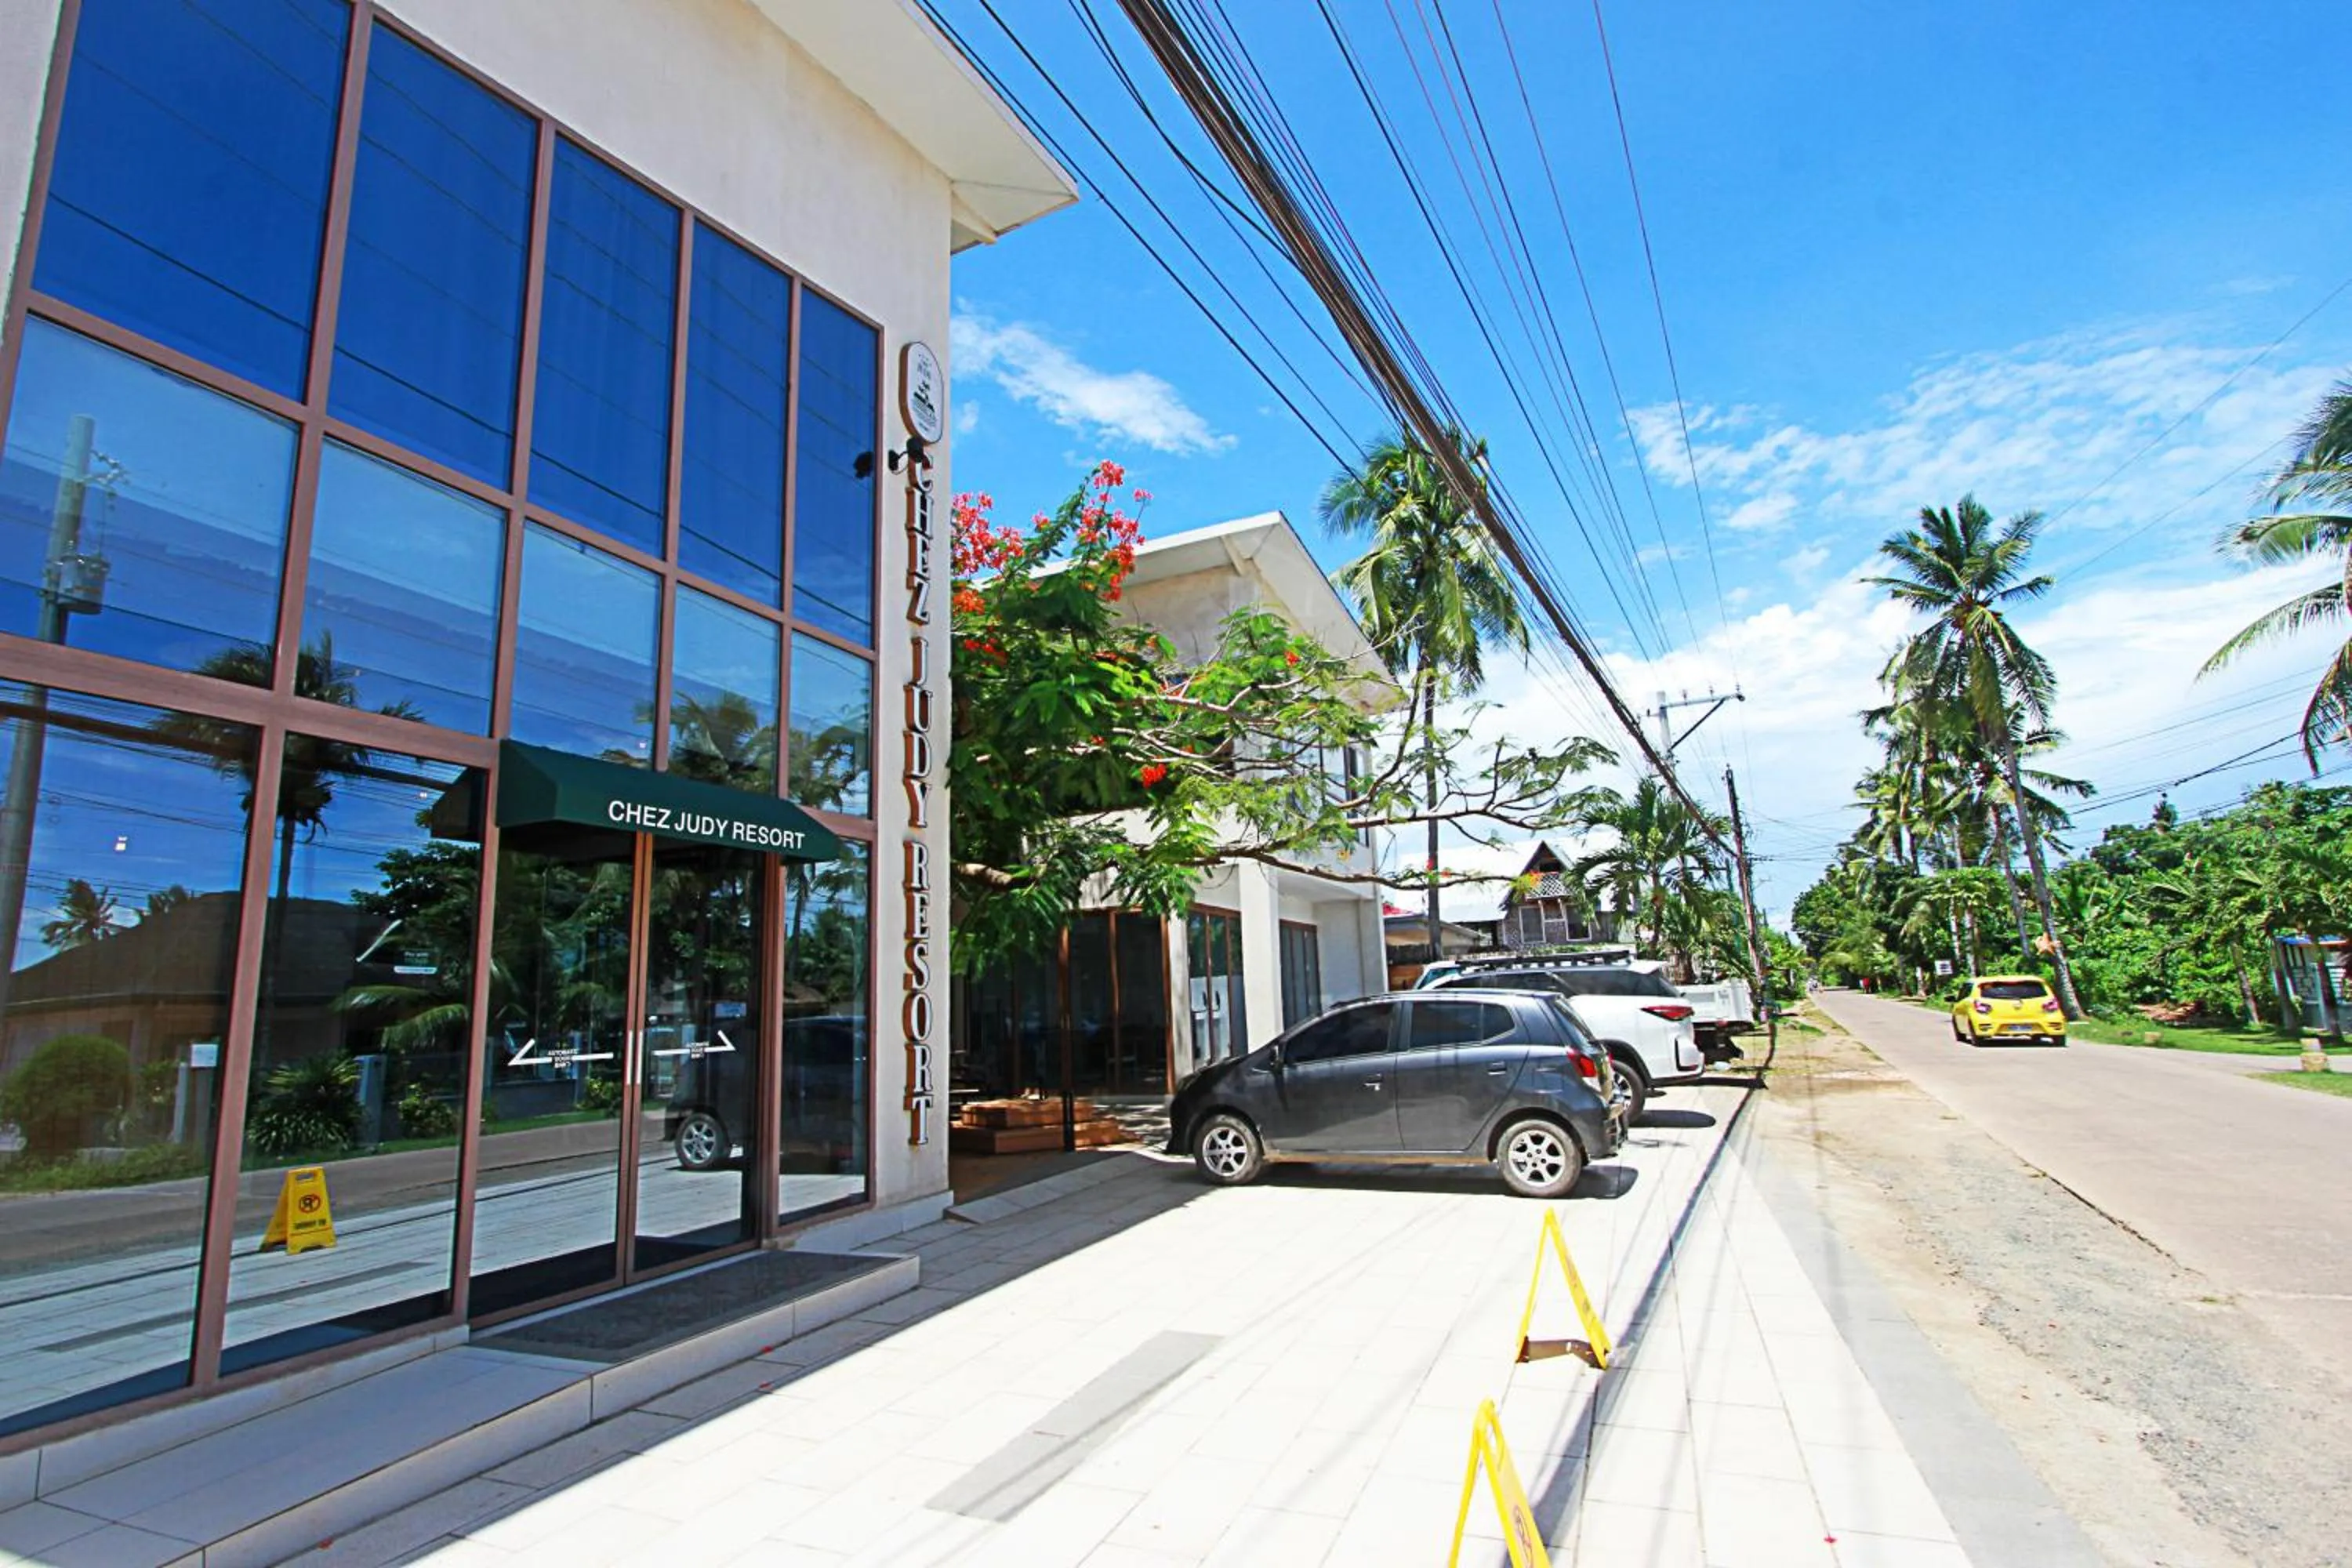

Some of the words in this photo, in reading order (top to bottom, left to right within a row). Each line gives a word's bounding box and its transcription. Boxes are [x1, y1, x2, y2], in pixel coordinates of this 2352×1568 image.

[906, 448, 934, 625] CHEZ
[904, 637, 932, 828] JUDY
[608, 800, 671, 829] CHEZ
[674, 812, 728, 838] JUDY
[732, 821, 805, 850] RESORT
[903, 840, 933, 1145] RESORT
